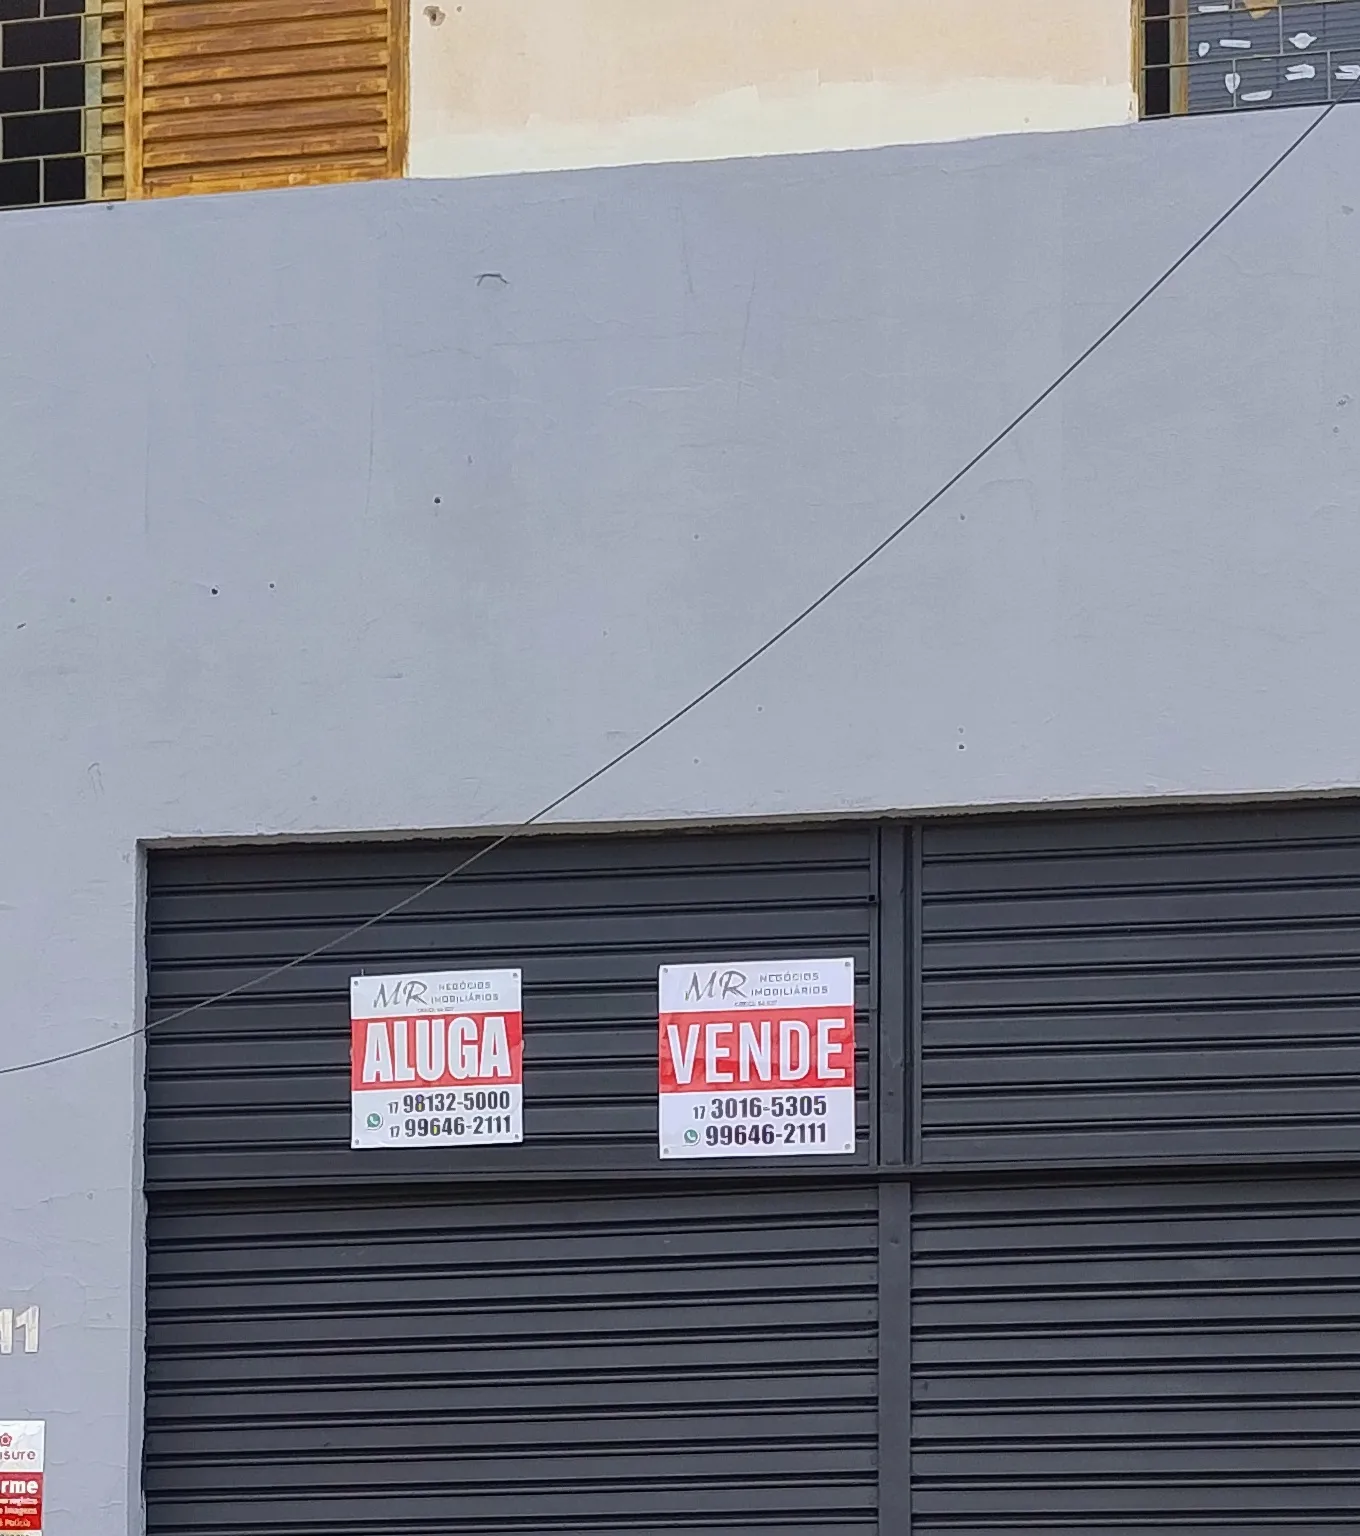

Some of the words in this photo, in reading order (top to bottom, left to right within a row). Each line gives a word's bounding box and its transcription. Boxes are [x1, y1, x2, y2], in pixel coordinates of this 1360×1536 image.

[373, 980, 428, 1008] MR
[685, 970, 747, 1002] MR
[362, 1016, 512, 1083] ALUGA
[666, 1018, 846, 1084] VENDE
[388, 1101, 399, 1114] 17
[403, 1091, 510, 1114] 98132-5000
[693, 1106, 706, 1119] 17
[711, 1095, 827, 1119] 3016-5305
[390, 1126, 400, 1138] 17
[404, 1115, 511, 1138] 99646-2111
[705, 1123, 827, 1147] 99646-2111
